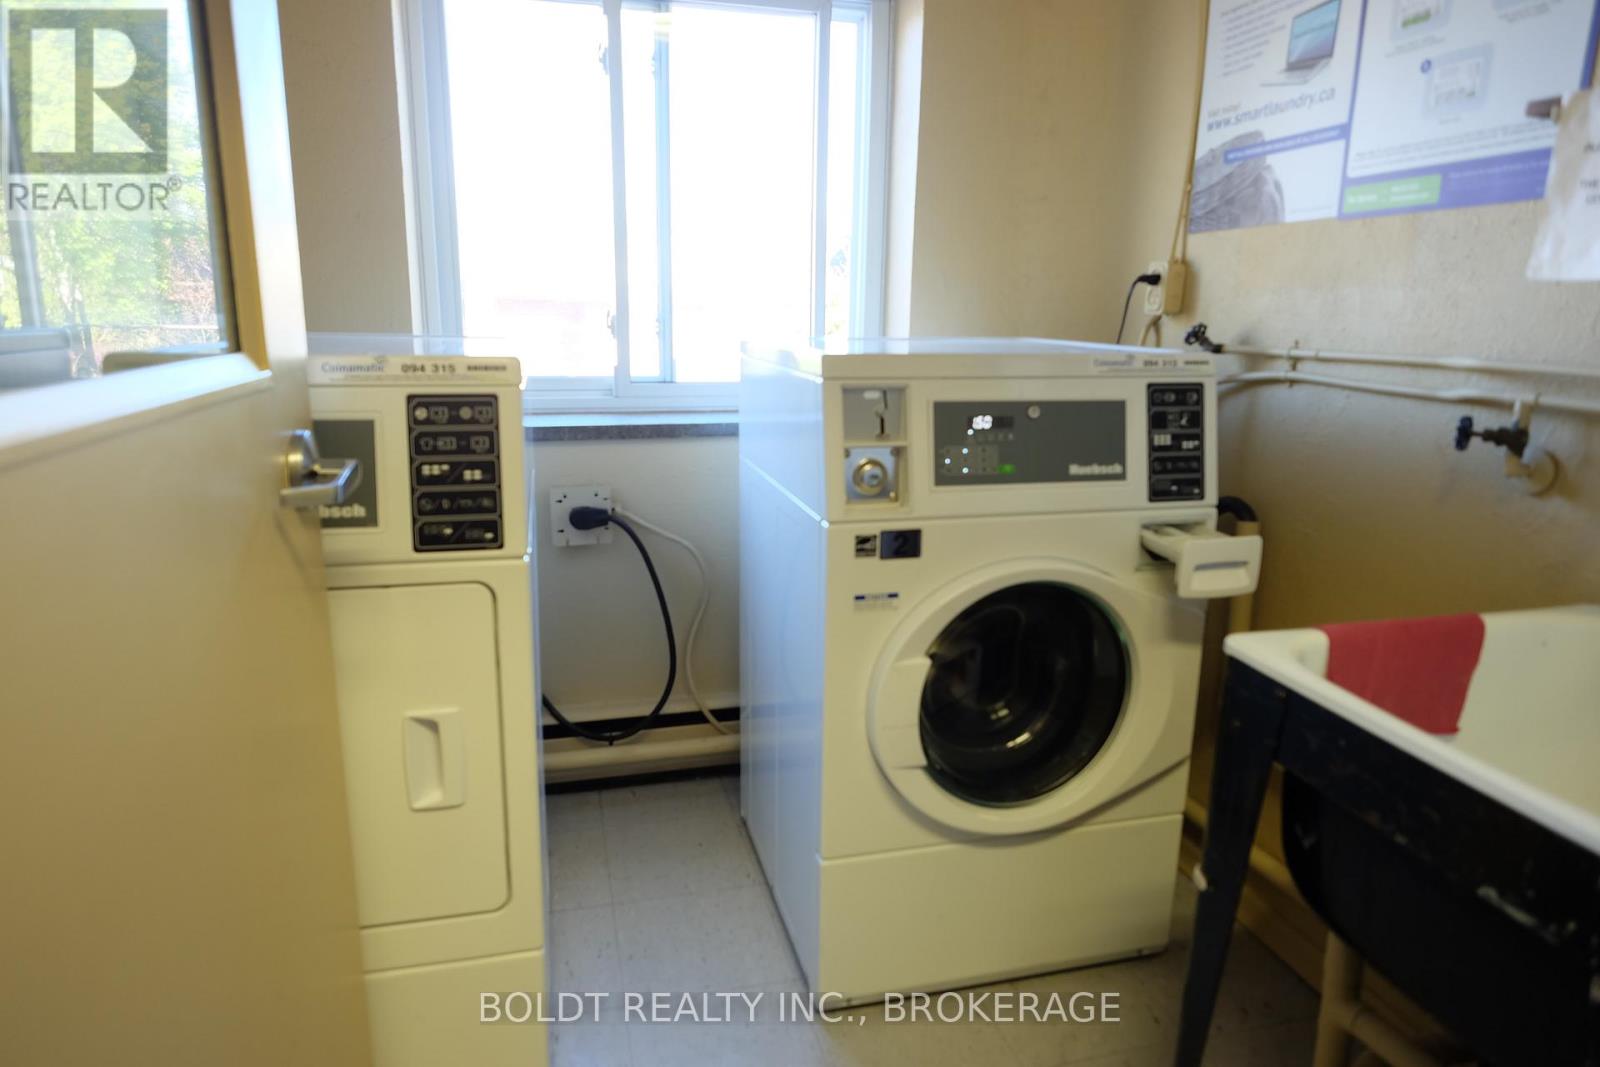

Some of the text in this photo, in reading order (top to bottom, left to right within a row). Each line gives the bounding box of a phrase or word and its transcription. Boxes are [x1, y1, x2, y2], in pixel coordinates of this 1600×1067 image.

[1206, 87, 1337, 131] www.smartlaundry.ca
[400, 364, 427, 374] 094
[431, 364, 457, 374] 315
[318, 502, 367, 519] bsch
[893, 533, 910, 556] 2
